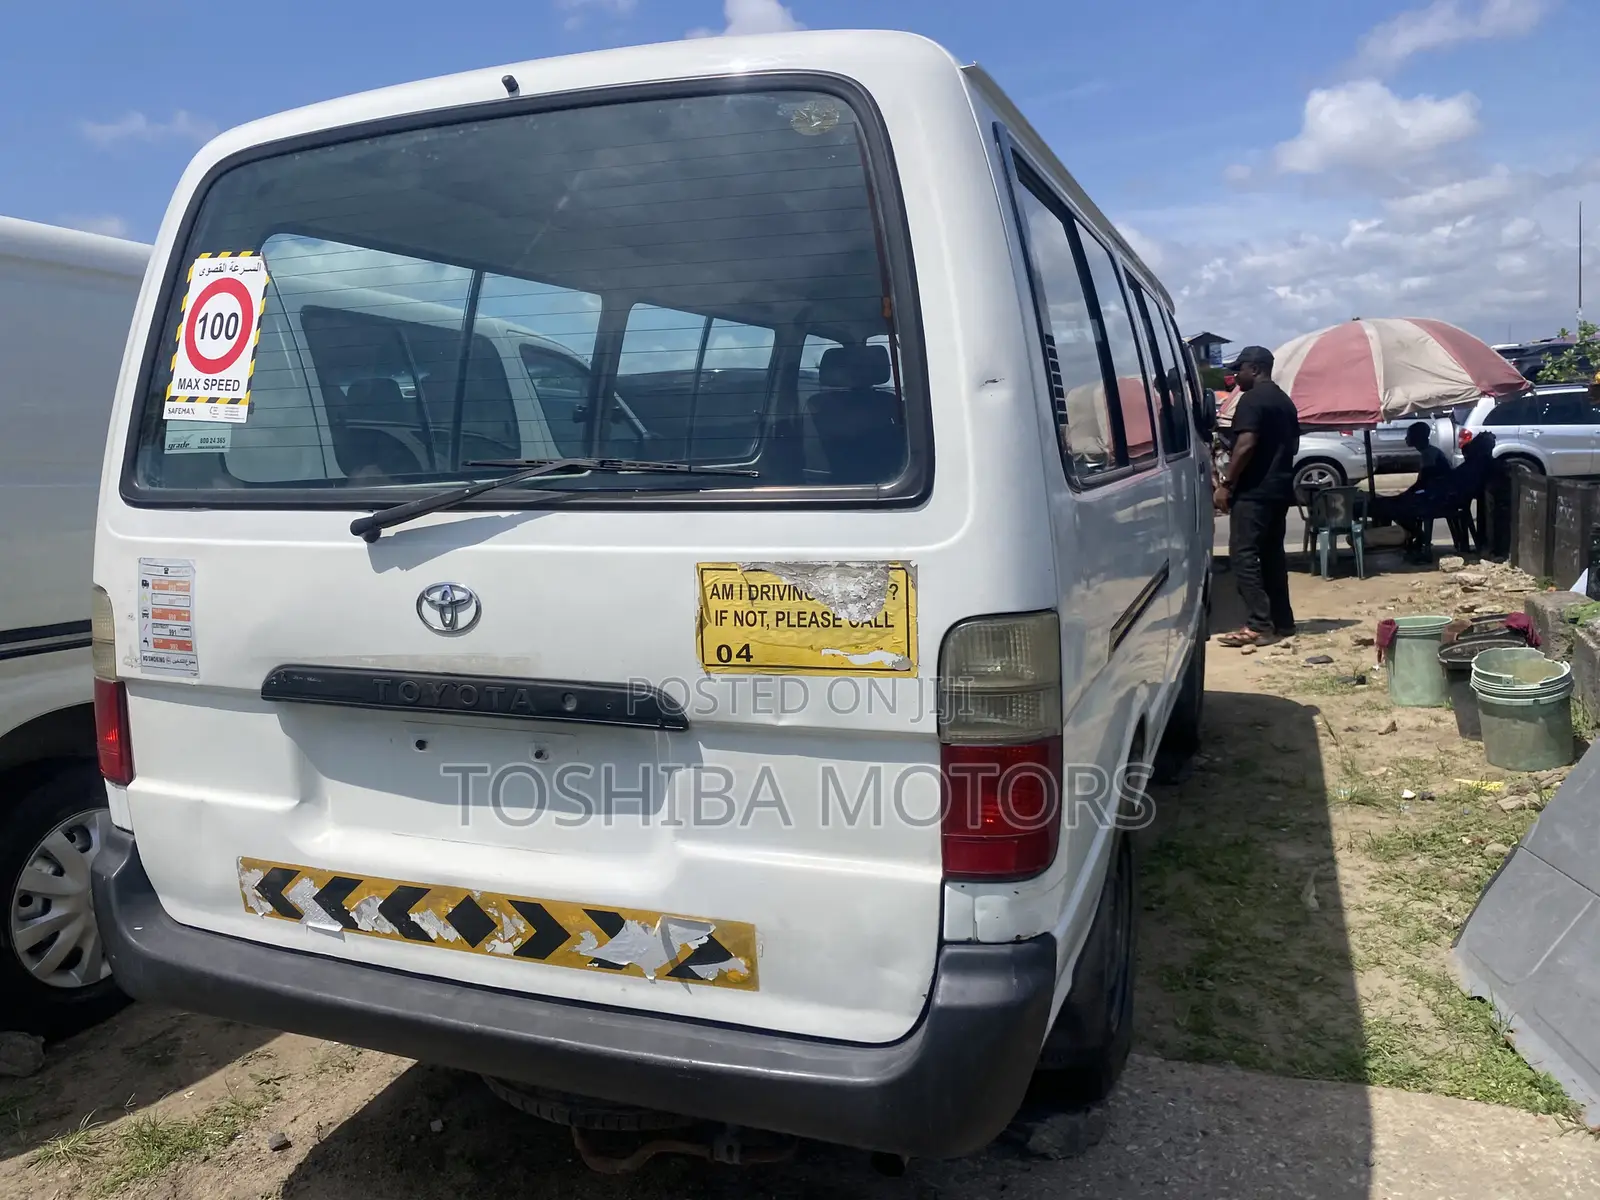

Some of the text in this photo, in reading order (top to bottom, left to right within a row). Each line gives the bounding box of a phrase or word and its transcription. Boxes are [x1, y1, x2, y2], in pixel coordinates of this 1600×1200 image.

[199, 261, 262, 276] السرعة القصوى
[198, 312, 239, 341] 100
[178, 378, 241, 392] MAX SPEED
[168, 407, 196, 415] SAFEMAX
[709, 583, 734, 600] AM
[739, 584, 743, 600] I
[715, 609, 729, 627] IF
[734, 610, 770, 630] NOT,
[776, 611, 842, 628] PLEASE
[716, 643, 754, 663] 04
[372, 678, 536, 712] TOYOTA
